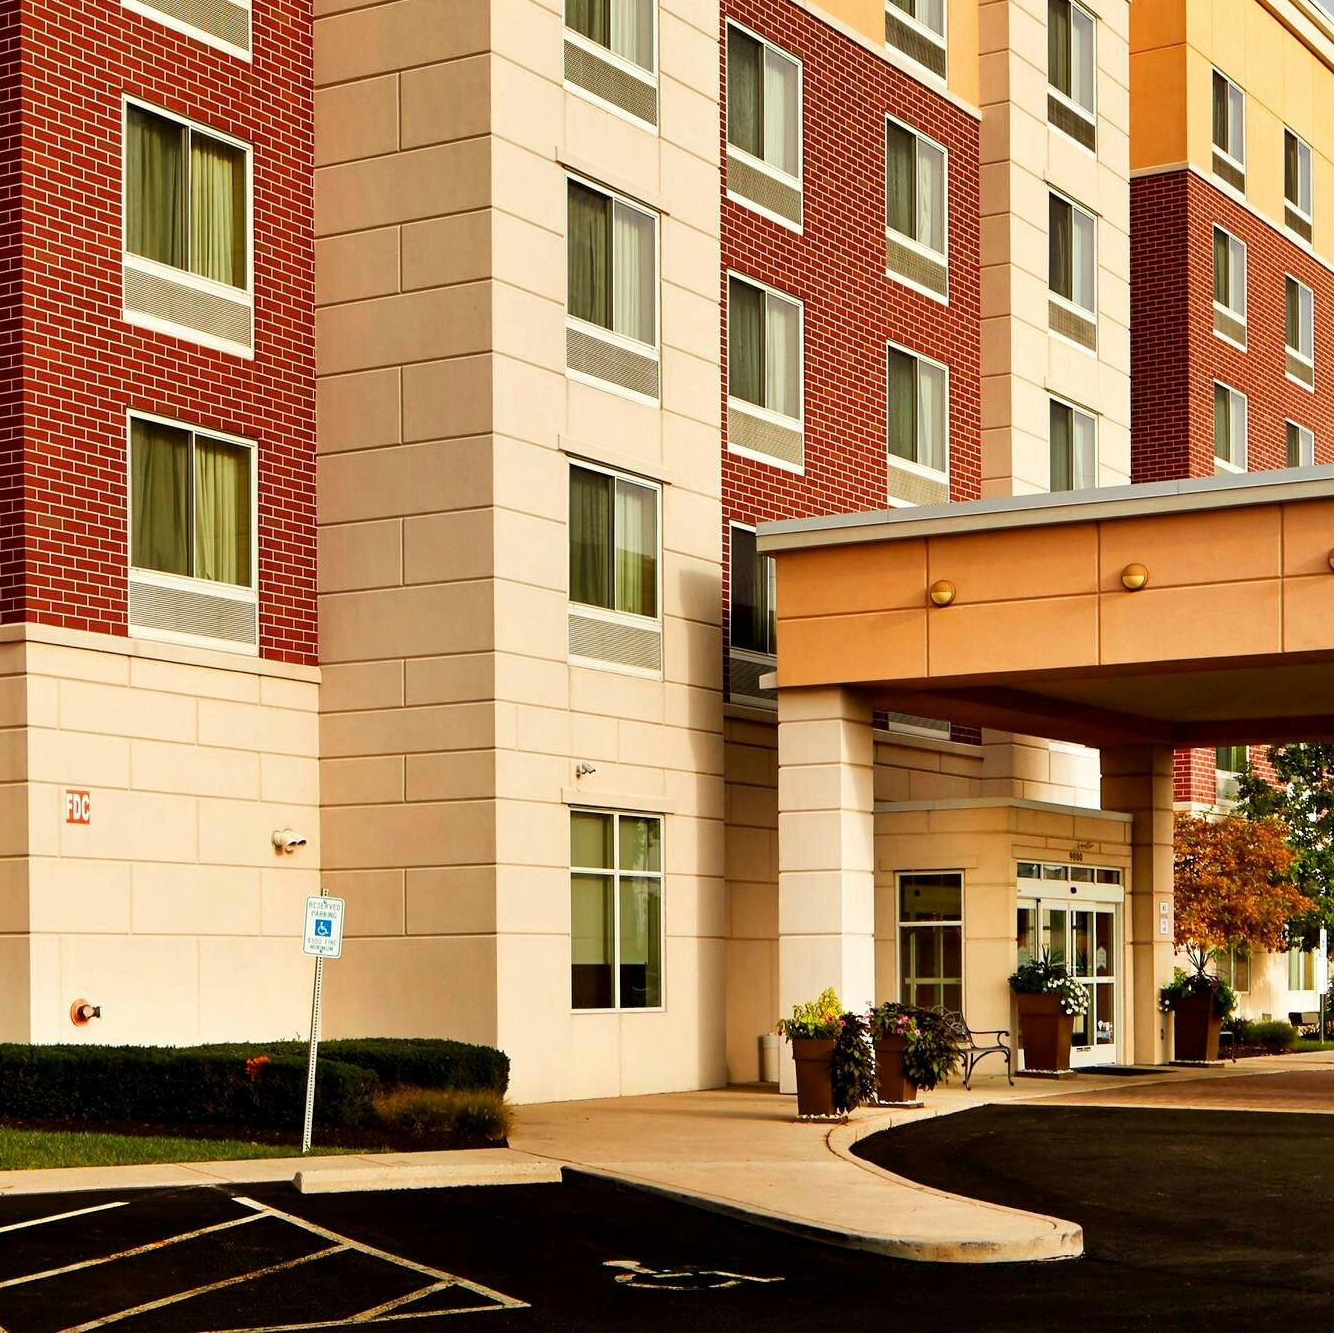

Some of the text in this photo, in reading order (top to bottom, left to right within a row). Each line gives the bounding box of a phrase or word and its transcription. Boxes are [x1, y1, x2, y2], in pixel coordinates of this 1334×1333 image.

[67, 793, 90, 821] FDC
[308, 900, 341, 912] RESERVED
[311, 909, 338, 919] PARKING
